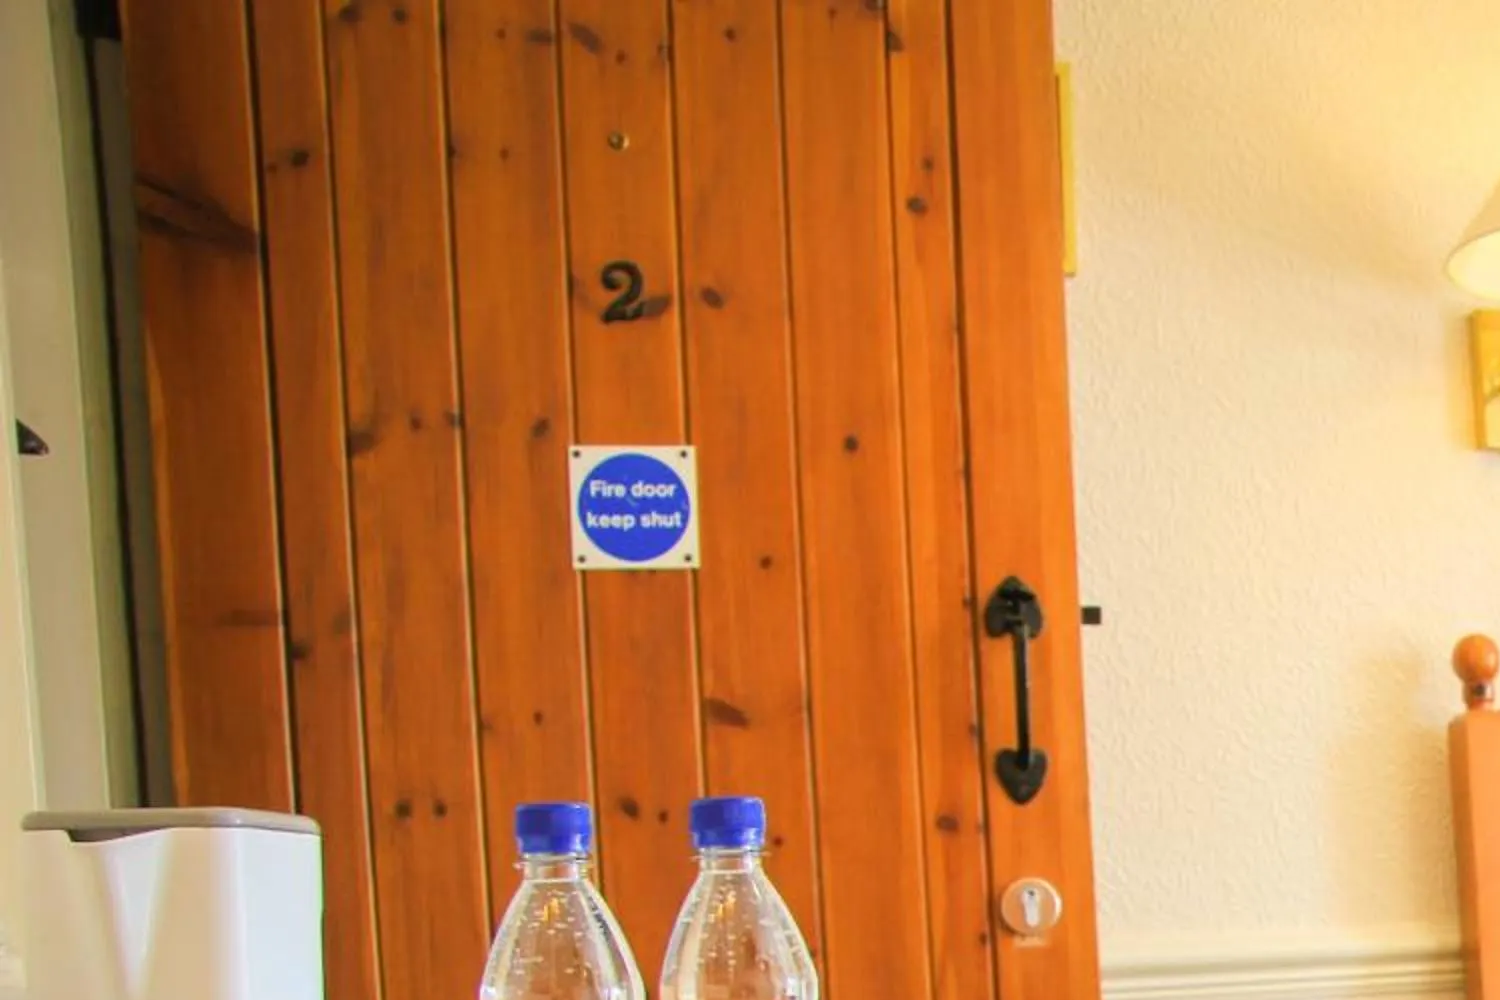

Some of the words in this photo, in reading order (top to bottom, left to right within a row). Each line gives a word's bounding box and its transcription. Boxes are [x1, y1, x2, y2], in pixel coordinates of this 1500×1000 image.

[600, 260, 643, 324] 2
[589, 480, 626, 498] Fire
[631, 480, 676, 498] door
[586, 511, 636, 532] keep
[640, 511, 682, 529] shut
